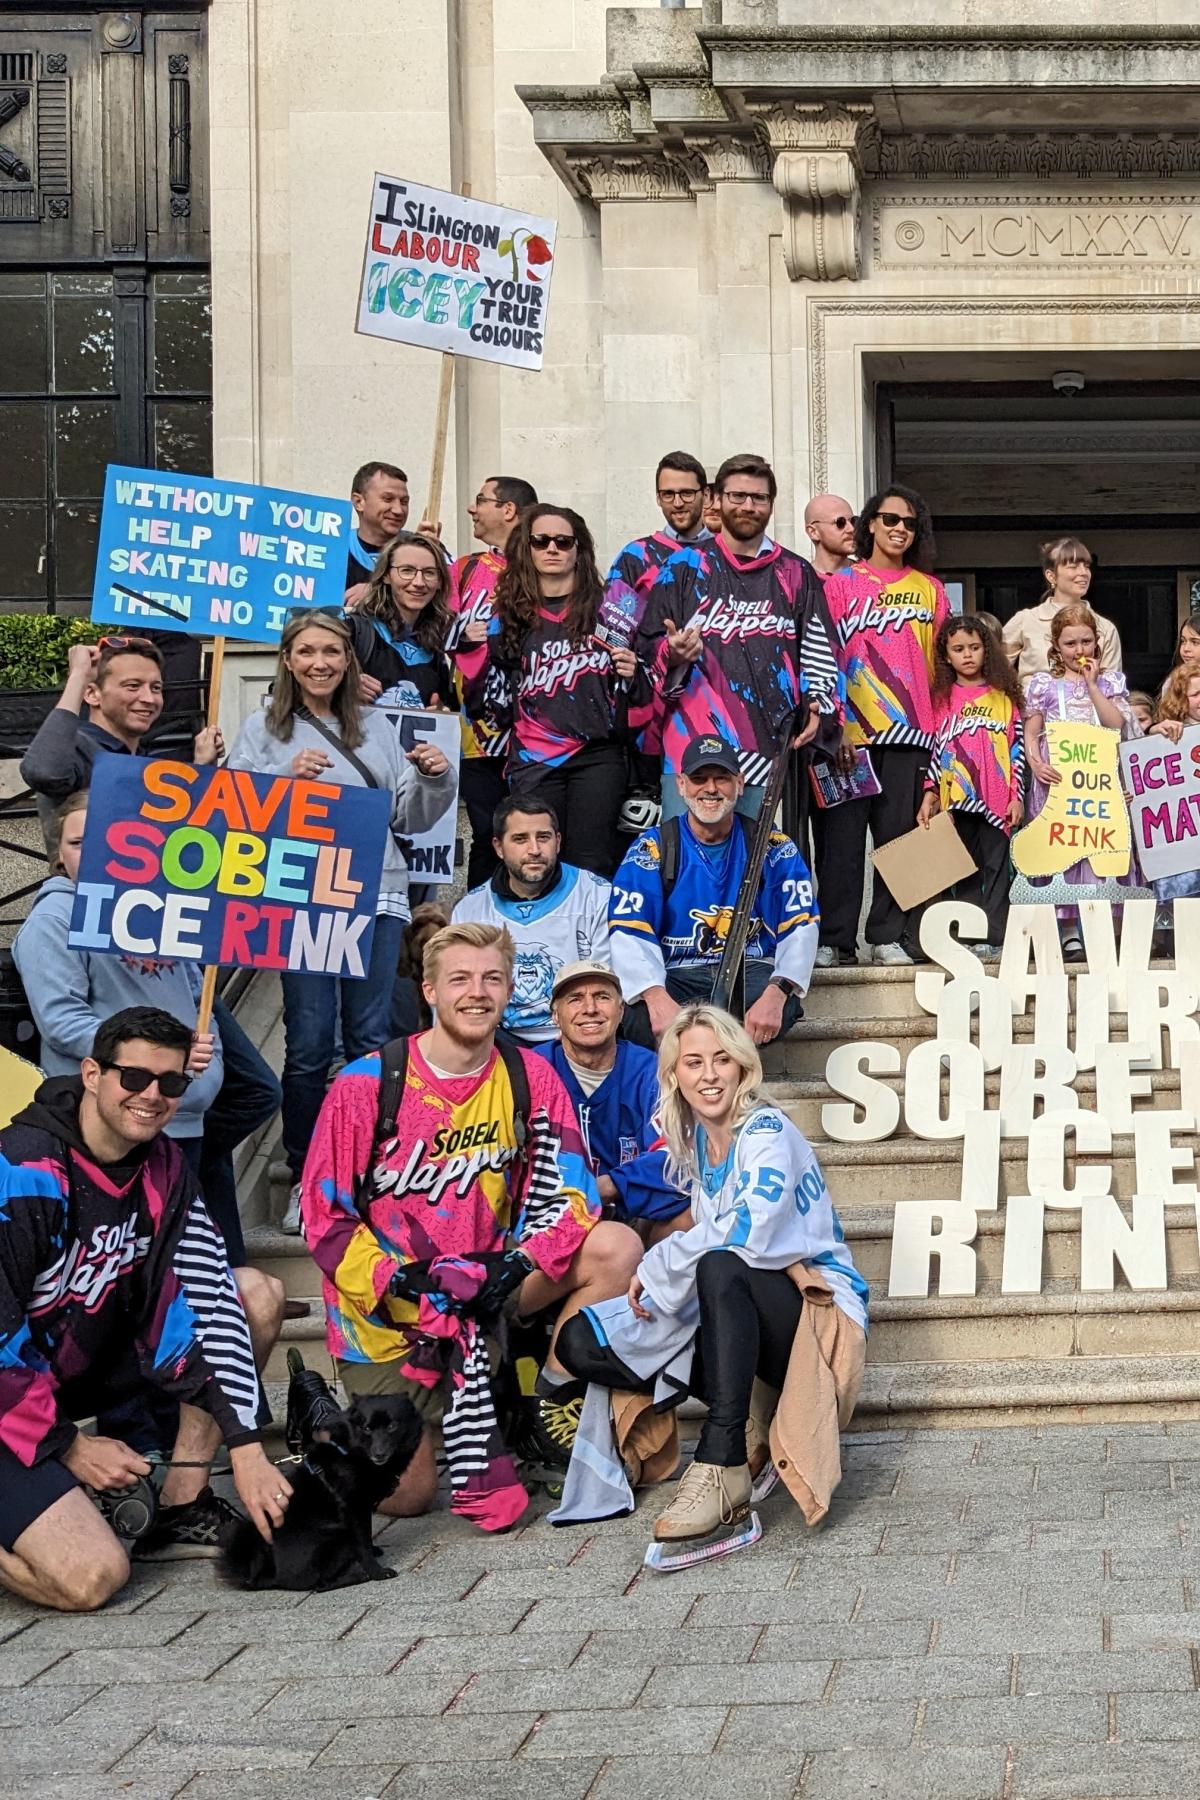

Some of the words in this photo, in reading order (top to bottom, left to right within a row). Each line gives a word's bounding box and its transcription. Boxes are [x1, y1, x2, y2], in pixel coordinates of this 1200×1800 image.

[371, 223, 481, 273] LABOUR
[367, 261, 487, 329] ICEY
[484, 276, 544, 308] YOUR
[480, 298, 542, 329] TRUE
[469, 323, 544, 355] COLOURS
[115, 480, 254, 520] WITHOUT
[268, 500, 343, 537] YOUR
[128, 517, 212, 550] HELP
[239, 531, 327, 569] WE'RE
[109, 548, 248, 588] SKATING
[274, 572, 315, 601] ON
[210, 598, 253, 625] NO
[876, 592, 921, 607] SOBELL
[960, 706, 994, 717] SOBELL
[1058, 739, 1098, 764] SAVE
[1071, 769, 1111, 791] OUR
[139, 759, 342, 842] SAVE
[1065, 798, 1110, 820] ICE
[1049, 822, 1116, 850] RINK
[104, 821, 363, 909] SOBELL
[782, 880, 813, 913] 28
[68, 881, 211, 959] ICE
[219, 900, 372, 978] RINK
[960, 1108, 1198, 1211] ICE
